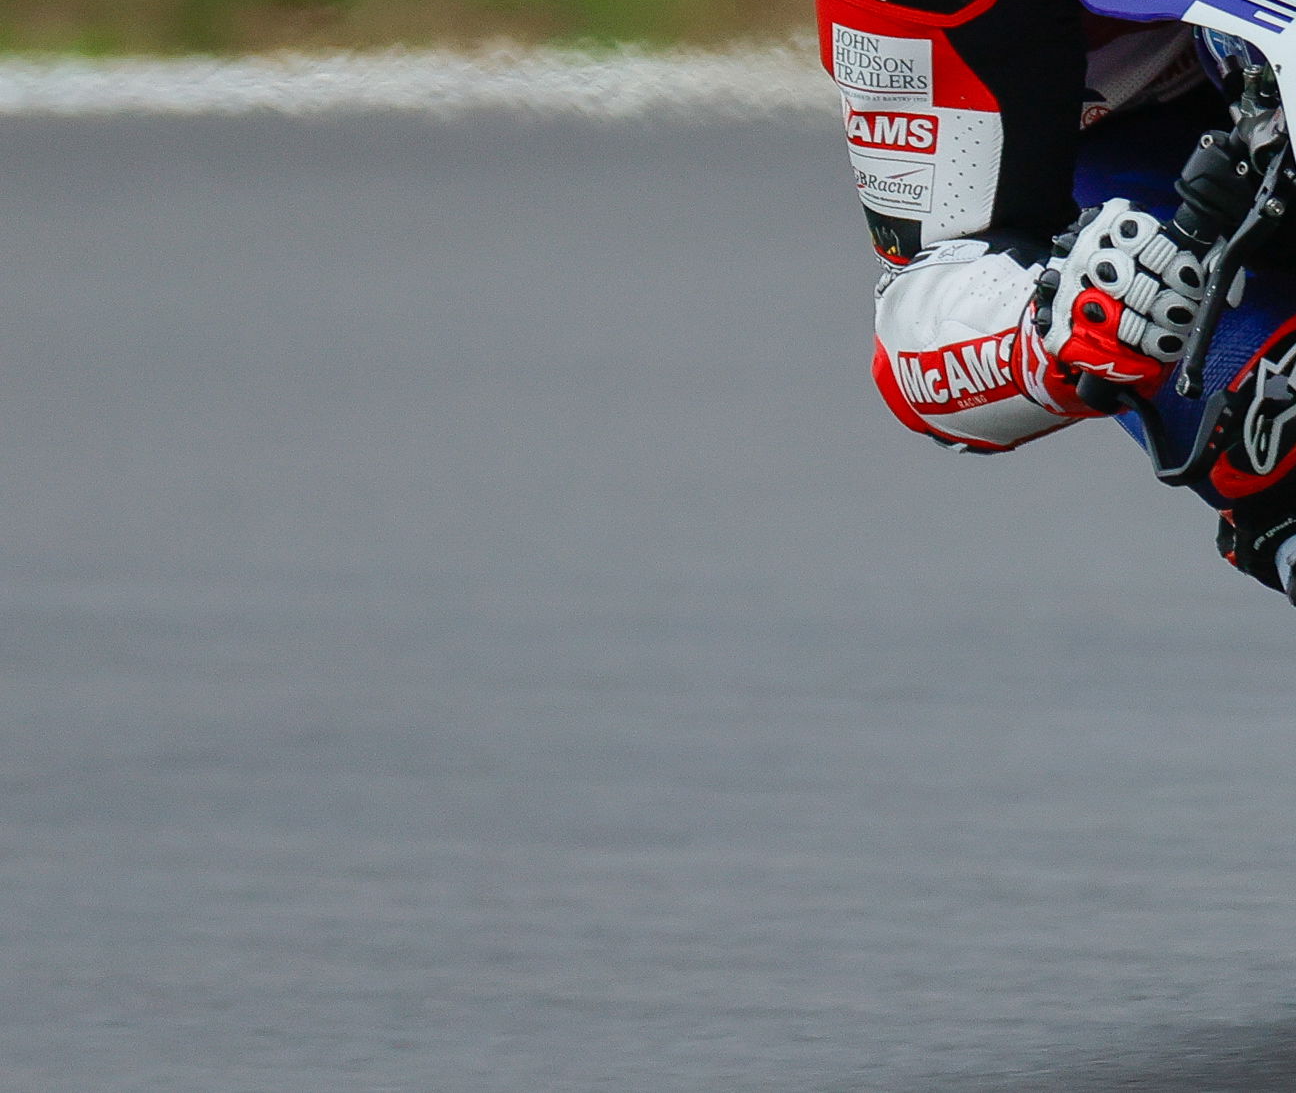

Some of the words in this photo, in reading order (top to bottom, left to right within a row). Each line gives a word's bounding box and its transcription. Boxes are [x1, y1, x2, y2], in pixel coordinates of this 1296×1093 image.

[835, 28, 880, 53] JOHN
[835, 44, 914, 74] HUDSON
[836, 62, 928, 90] TRAILERS
[847, 114, 934, 149] AMS
[957, 394, 988, 408] RACING
